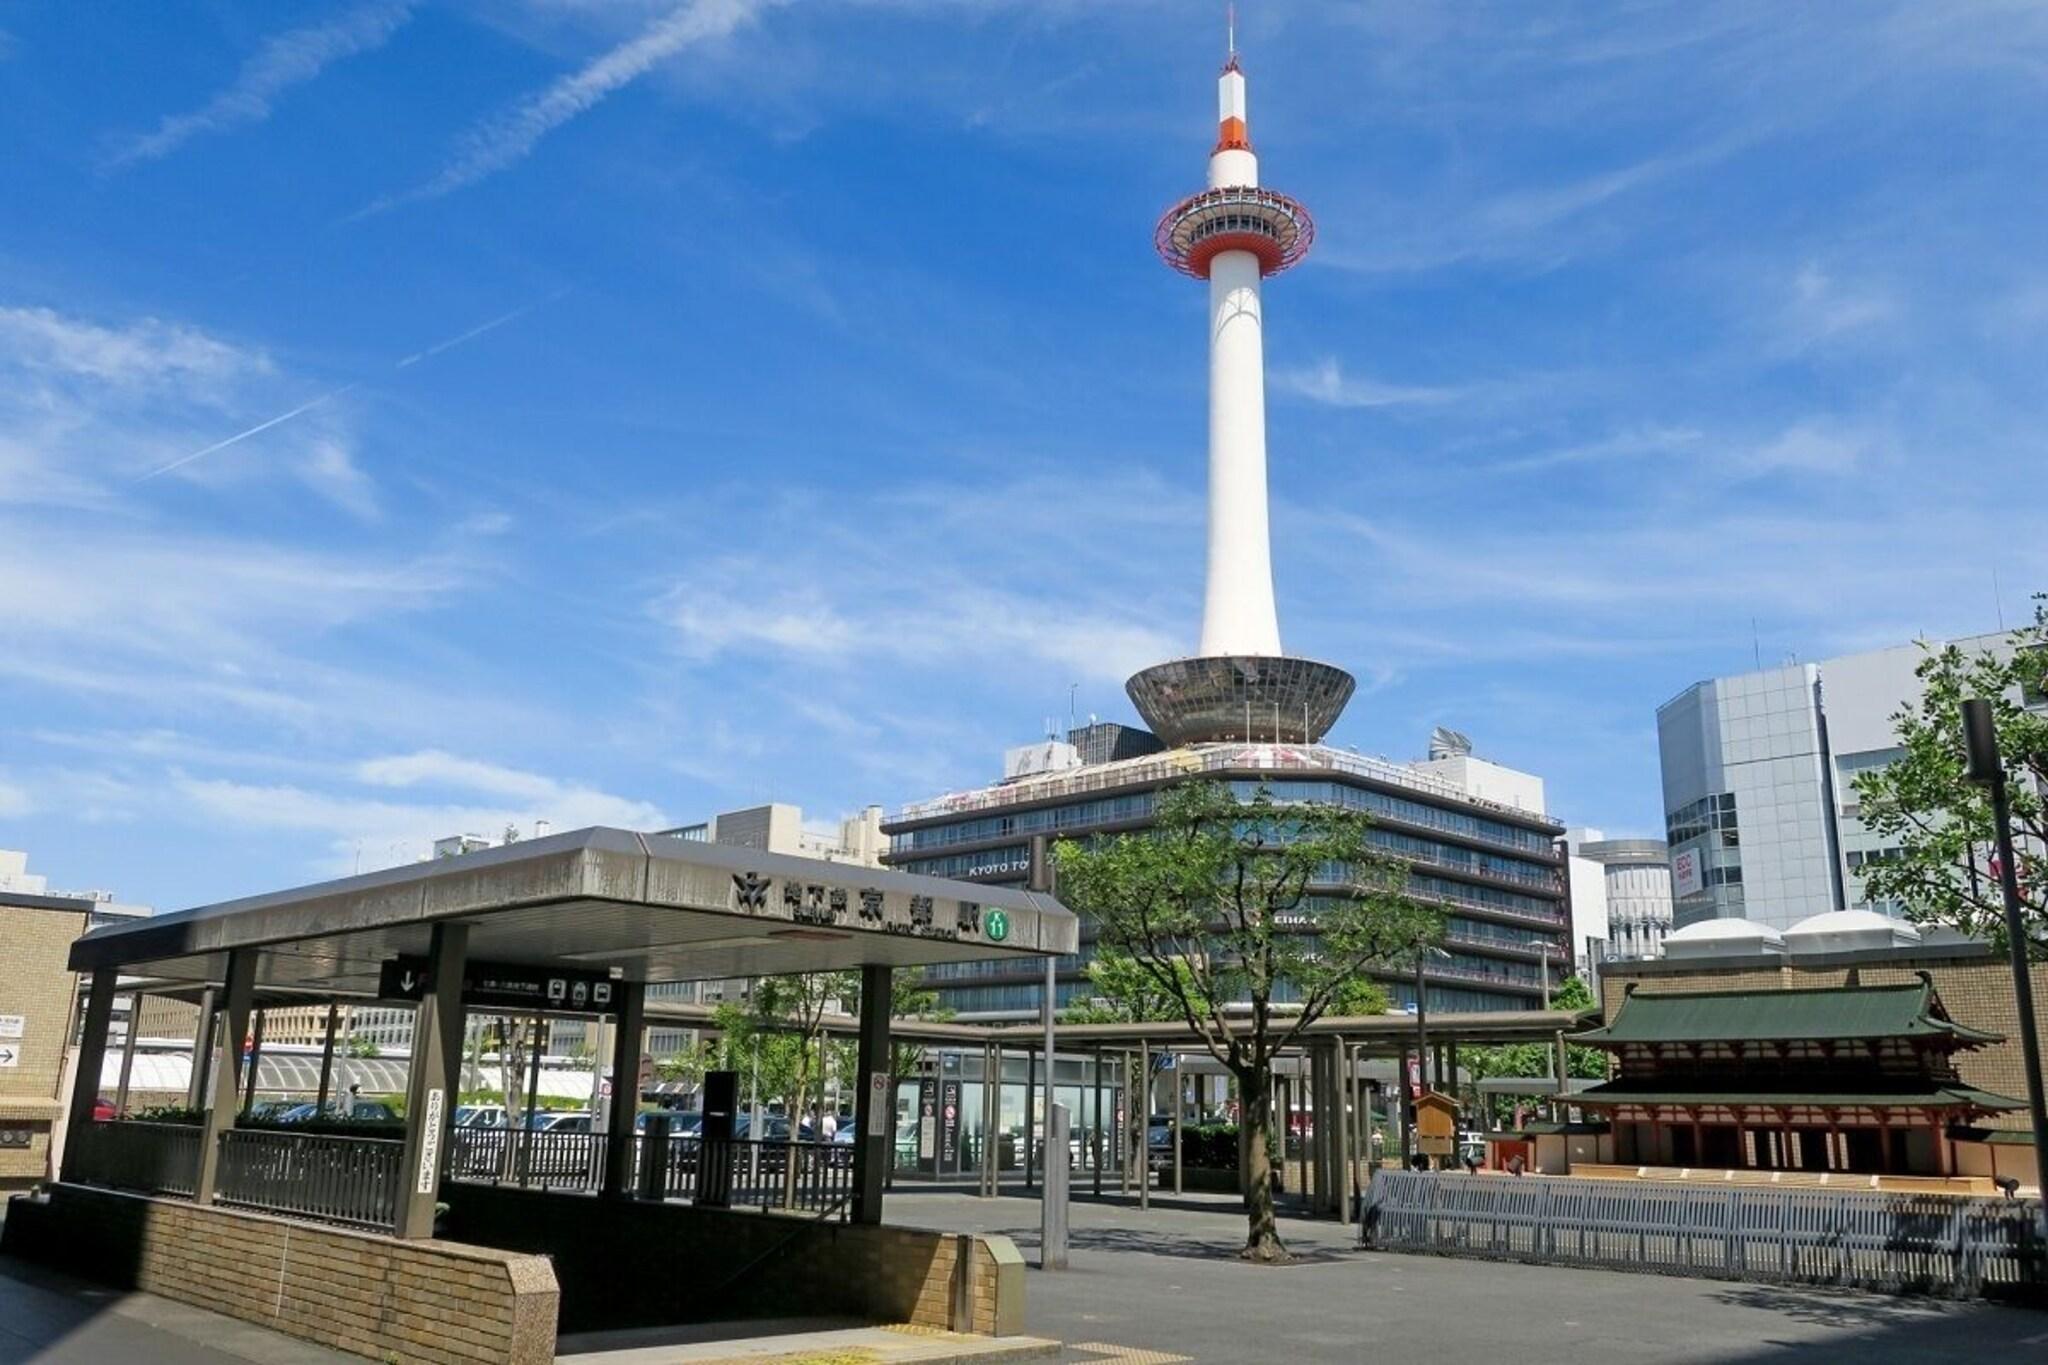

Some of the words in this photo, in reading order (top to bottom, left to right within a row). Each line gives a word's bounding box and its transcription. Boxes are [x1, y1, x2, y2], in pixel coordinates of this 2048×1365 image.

[968, 863, 1008, 876] KYOTO
[1012, 860, 1029, 871] TO
[990, 921, 1003, 936] 11
